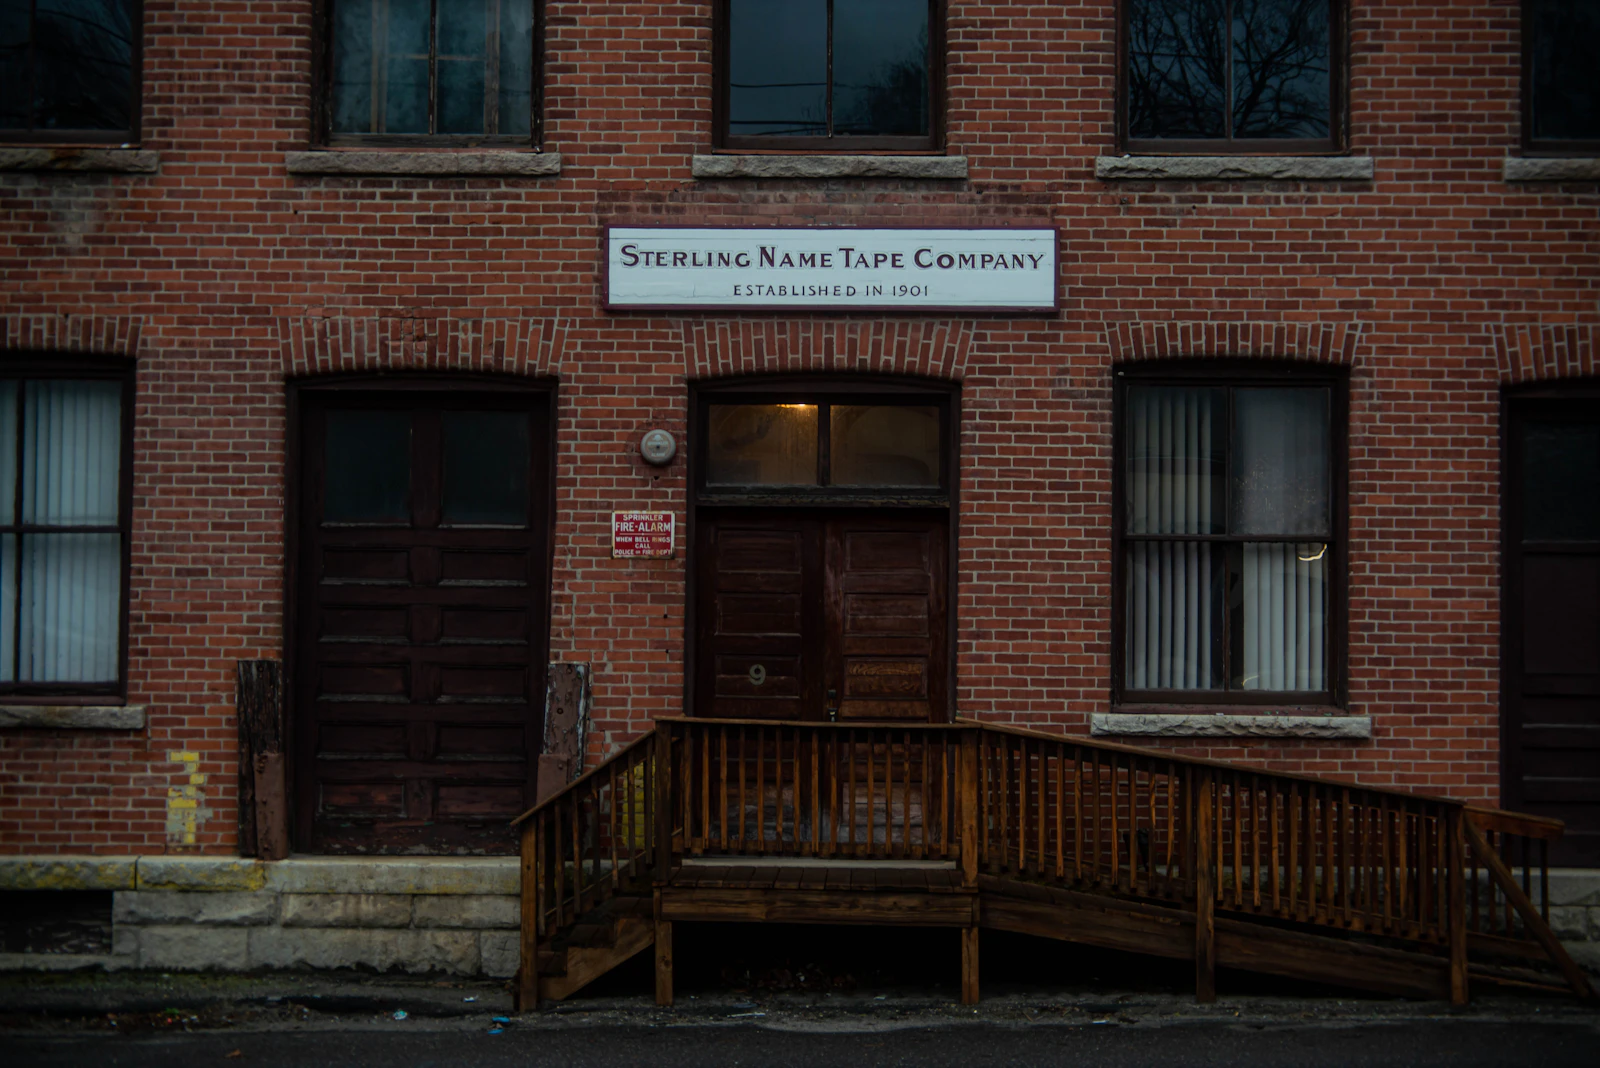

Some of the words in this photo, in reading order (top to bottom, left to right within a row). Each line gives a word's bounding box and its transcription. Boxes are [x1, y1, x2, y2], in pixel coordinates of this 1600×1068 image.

[620, 244, 751, 268] STERLING
[759, 246, 832, 268] NAME
[838, 247, 904, 268] TAPE
[914, 248, 1044, 269] COMPANY
[733, 284, 857, 297] ESTABLISHED
[865, 284, 883, 297] IN
[892, 284, 929, 297] 1901
[749, 664, 766, 685] 9
